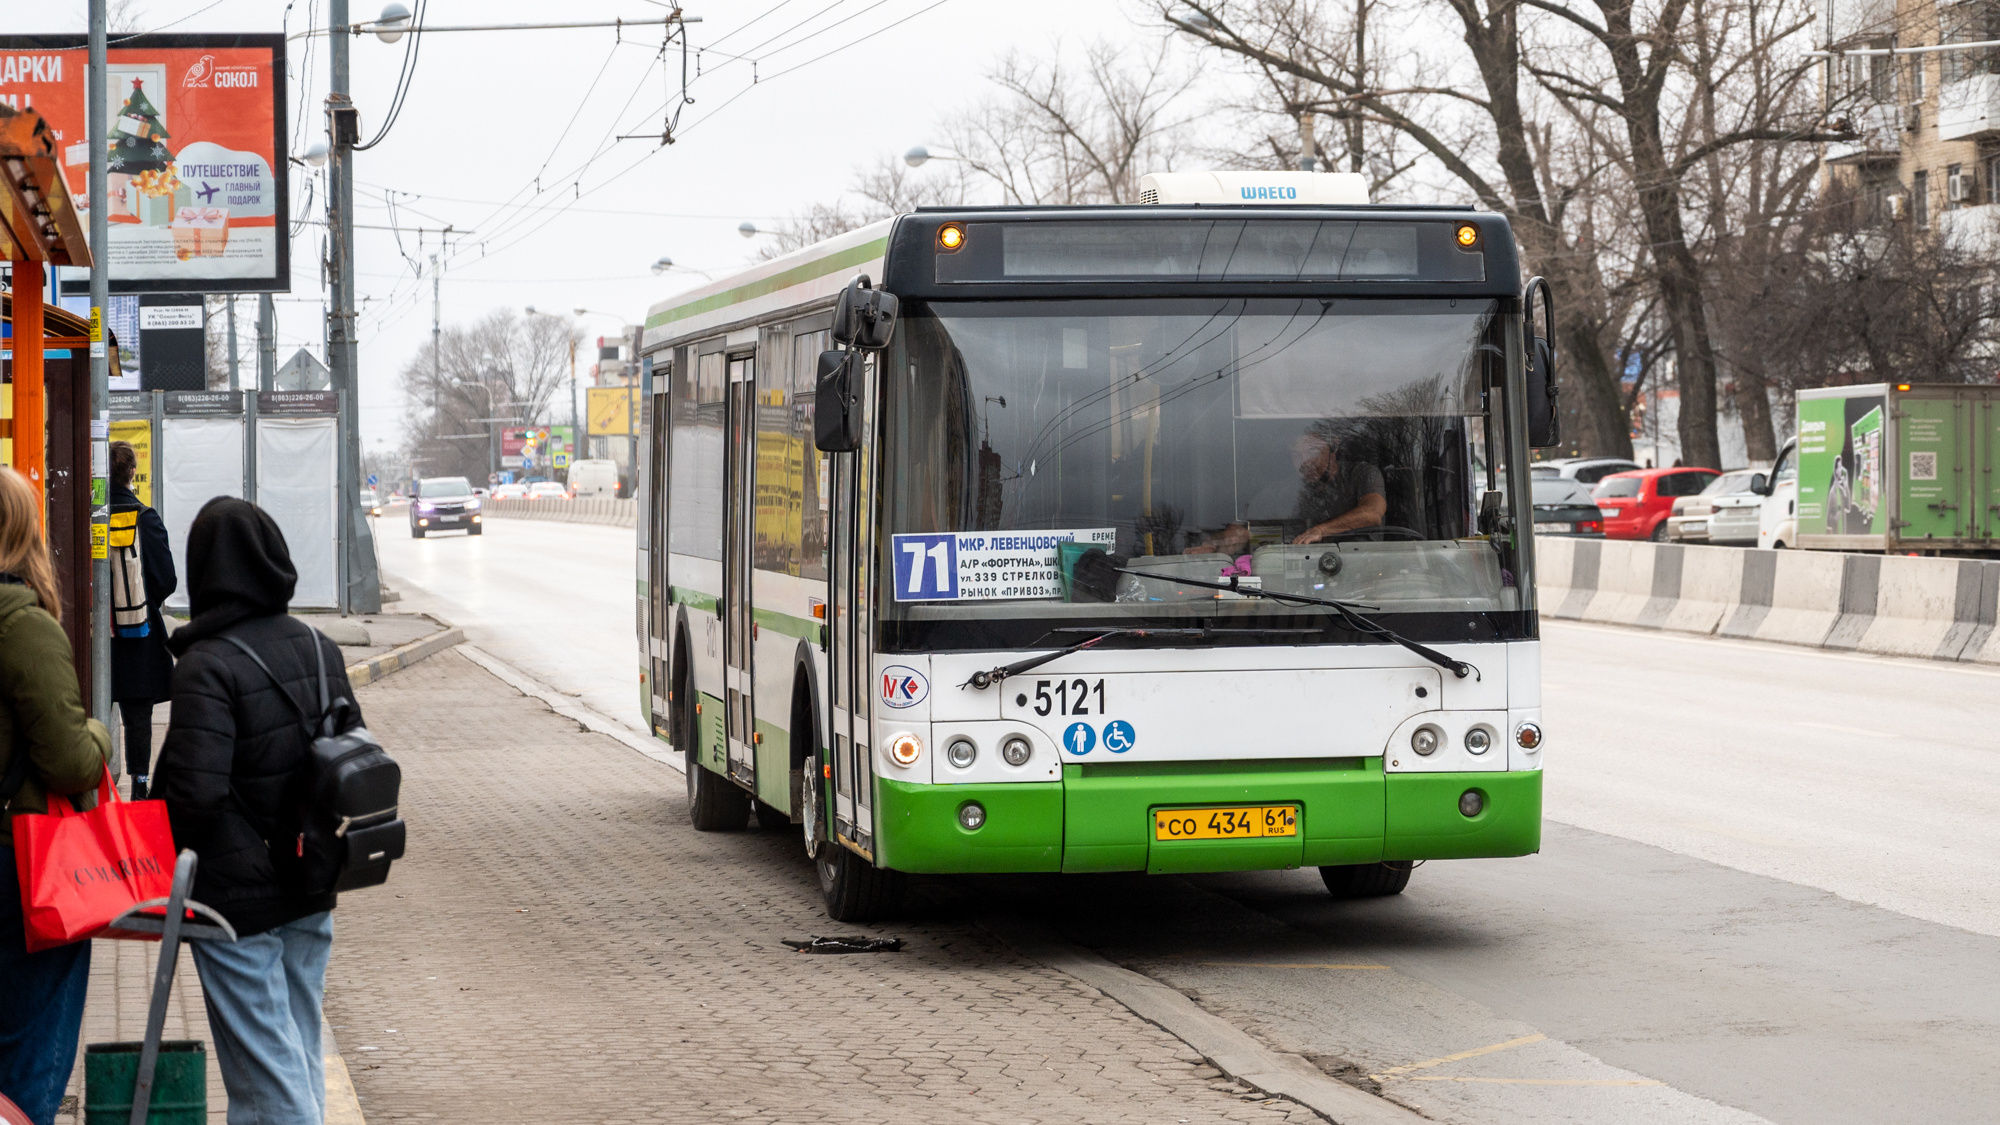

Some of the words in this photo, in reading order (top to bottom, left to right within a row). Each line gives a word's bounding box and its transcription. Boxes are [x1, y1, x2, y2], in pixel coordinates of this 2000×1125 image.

[0, 55, 62, 86] АРКИ
[214, 72, 258, 88] СОКОЛ
[182, 164, 260, 178] ПУТЕШЕСТВИЕ
[225, 181, 261, 192] ГЛАВНЫЙ
[1240, 186, 1296, 200] WAECO
[227, 195, 261, 205] ПОДАРОК
[959, 538, 988, 551] МКР.
[902, 542, 950, 592] 71
[960, 559, 979, 569] А/Р
[982, 558, 1042, 568] «ФОРТУНА»,
[975, 572, 997, 582] 339
[1002, 571, 1059, 581] СТРЕЛКОВ
[961, 588, 997, 597] РЫНОК
[1002, 587, 1051, 596] «ПРИВОЗ»,
[1034, 678, 1104, 716] 5121
[1208, 811, 1250, 834] 434
[1265, 809, 1287, 826] 61
